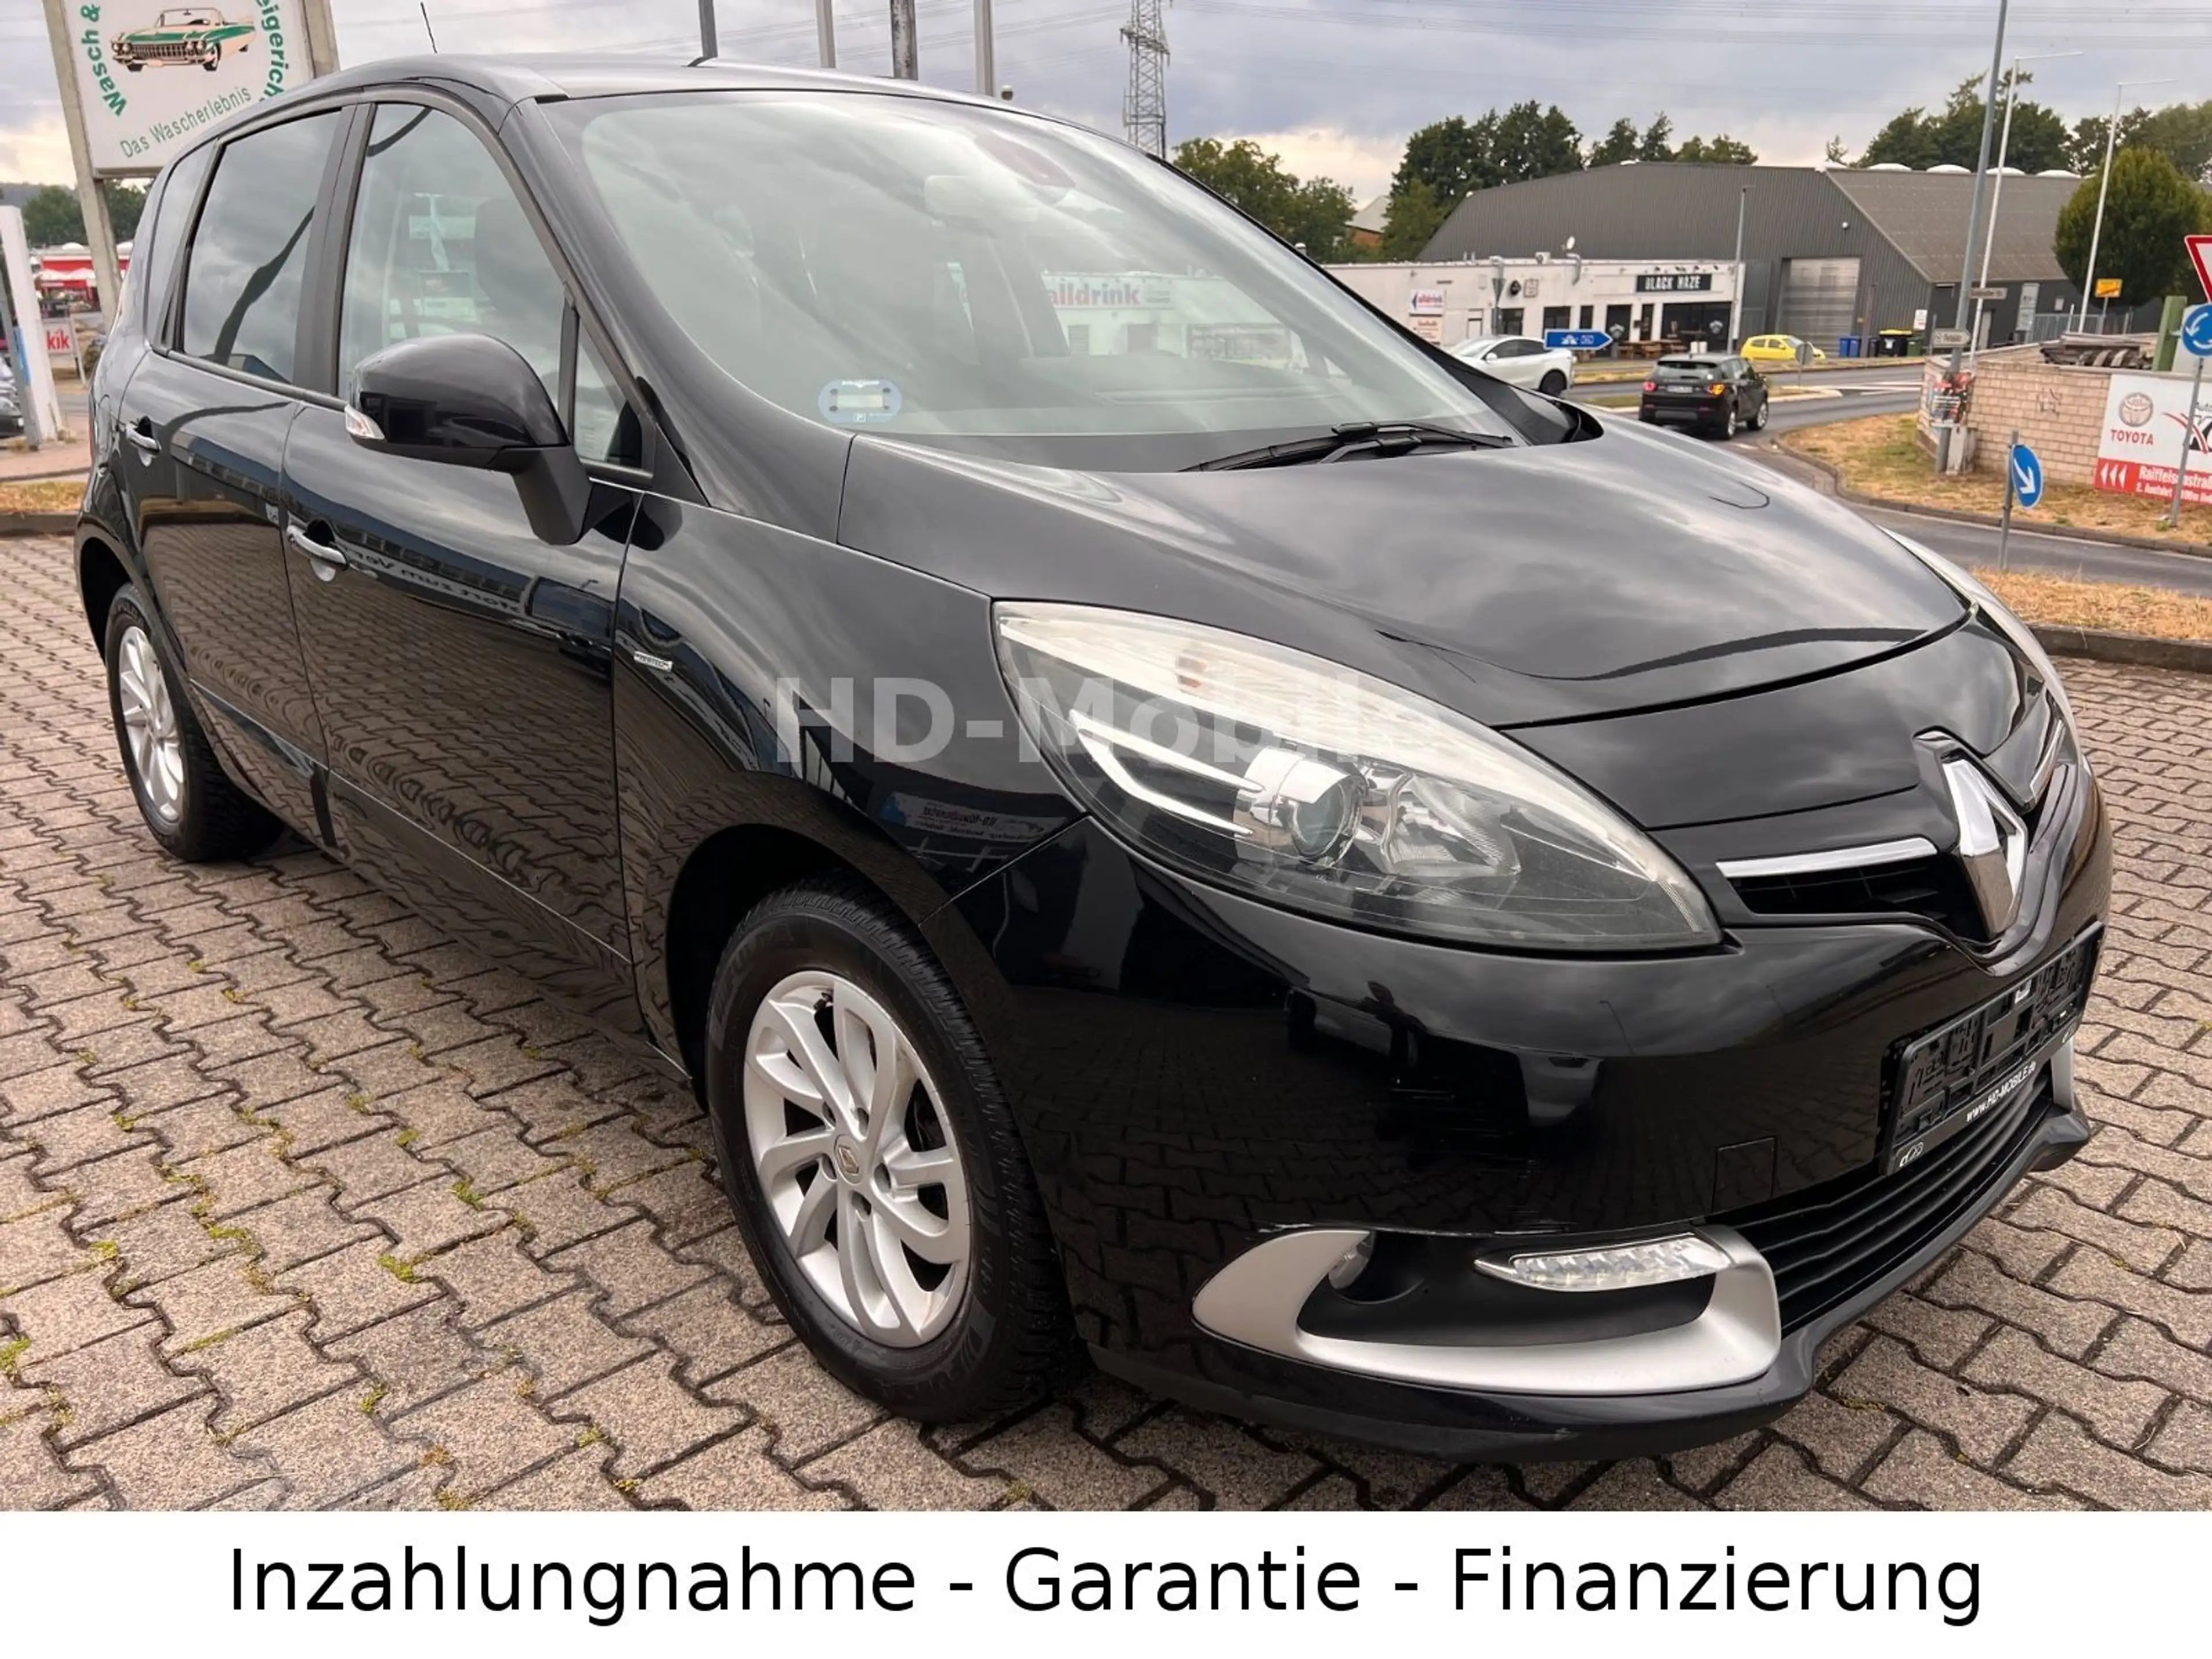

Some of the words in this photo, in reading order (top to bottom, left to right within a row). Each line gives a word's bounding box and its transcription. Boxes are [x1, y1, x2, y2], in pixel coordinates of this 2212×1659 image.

[80, 3, 101, 22] &
[81, 29, 128, 117] Wasch
[256, 0, 289, 102] eigerich
[120, 135, 150, 159] Das
[149, 86, 252, 145] Wascherlebnis
[47, 329, 70, 350] kik
[2111, 429, 2154, 446] TOYOTA
